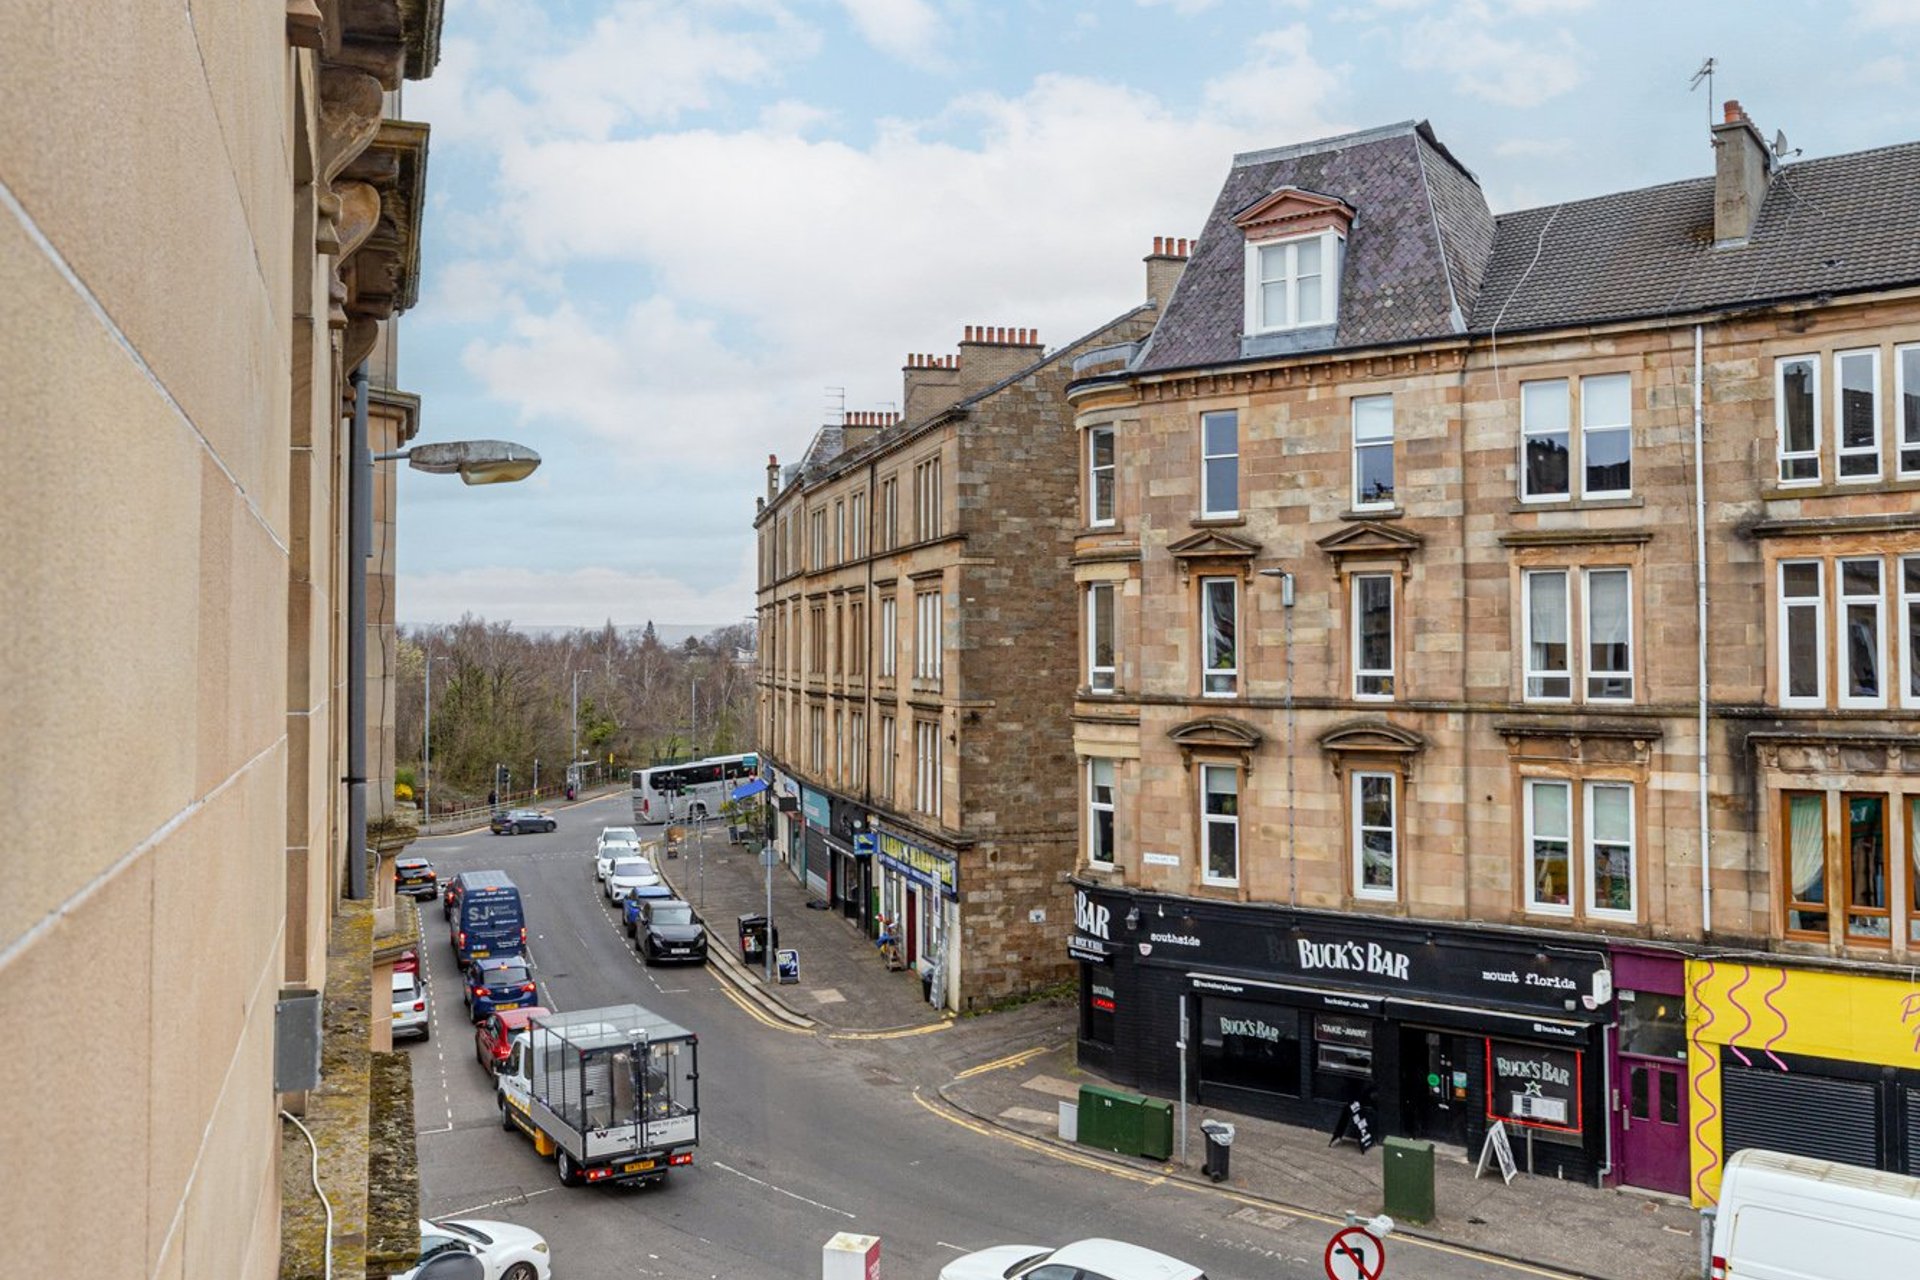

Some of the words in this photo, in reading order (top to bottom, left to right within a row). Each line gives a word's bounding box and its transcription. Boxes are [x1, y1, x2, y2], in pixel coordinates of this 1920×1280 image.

[468, 906, 490, 921] SJ
[1078, 889, 1111, 940] BAR
[1150, 932, 1201, 947] southside
[1367, 942, 1410, 981] BAR
[1481, 970, 1520, 984] mount
[1524, 973, 1577, 990] florida
[1256, 1020, 1280, 1043] BAR
[1541, 1060, 1571, 1086] BAR
